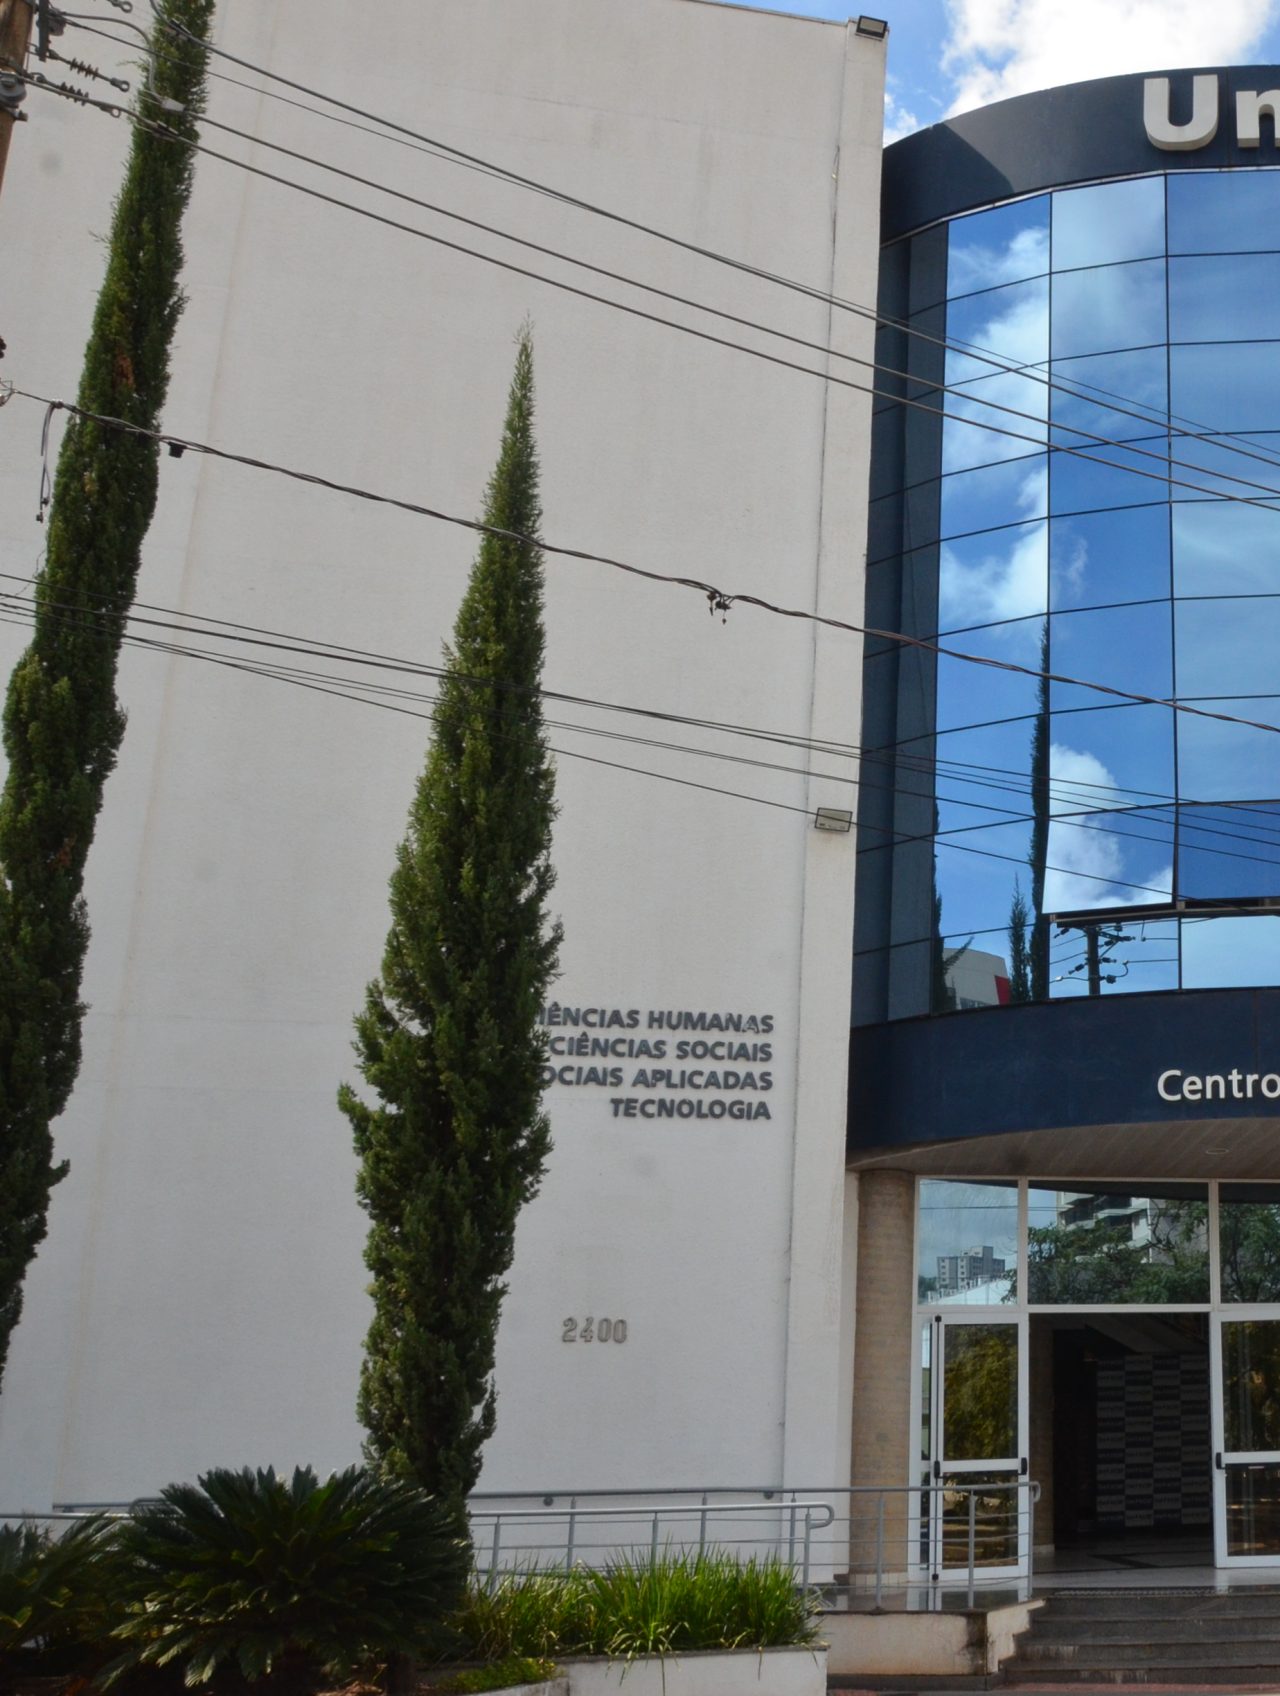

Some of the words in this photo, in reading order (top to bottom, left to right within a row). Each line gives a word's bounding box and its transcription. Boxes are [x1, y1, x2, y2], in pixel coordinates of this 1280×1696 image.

[535, 1002, 640, 1029] IÊNCIAS
[648, 1010, 774, 1034] HUMANAS
[549, 1031, 667, 1060] CIÊNCIAS
[676, 1040, 773, 1063] SOCIAIS
[539, 1065, 623, 1087] OCIAIS
[631, 1068, 773, 1091] APLICADAS
[610, 1098, 772, 1121] TECNOLOGIA
[562, 1316, 628, 1344] 2400
